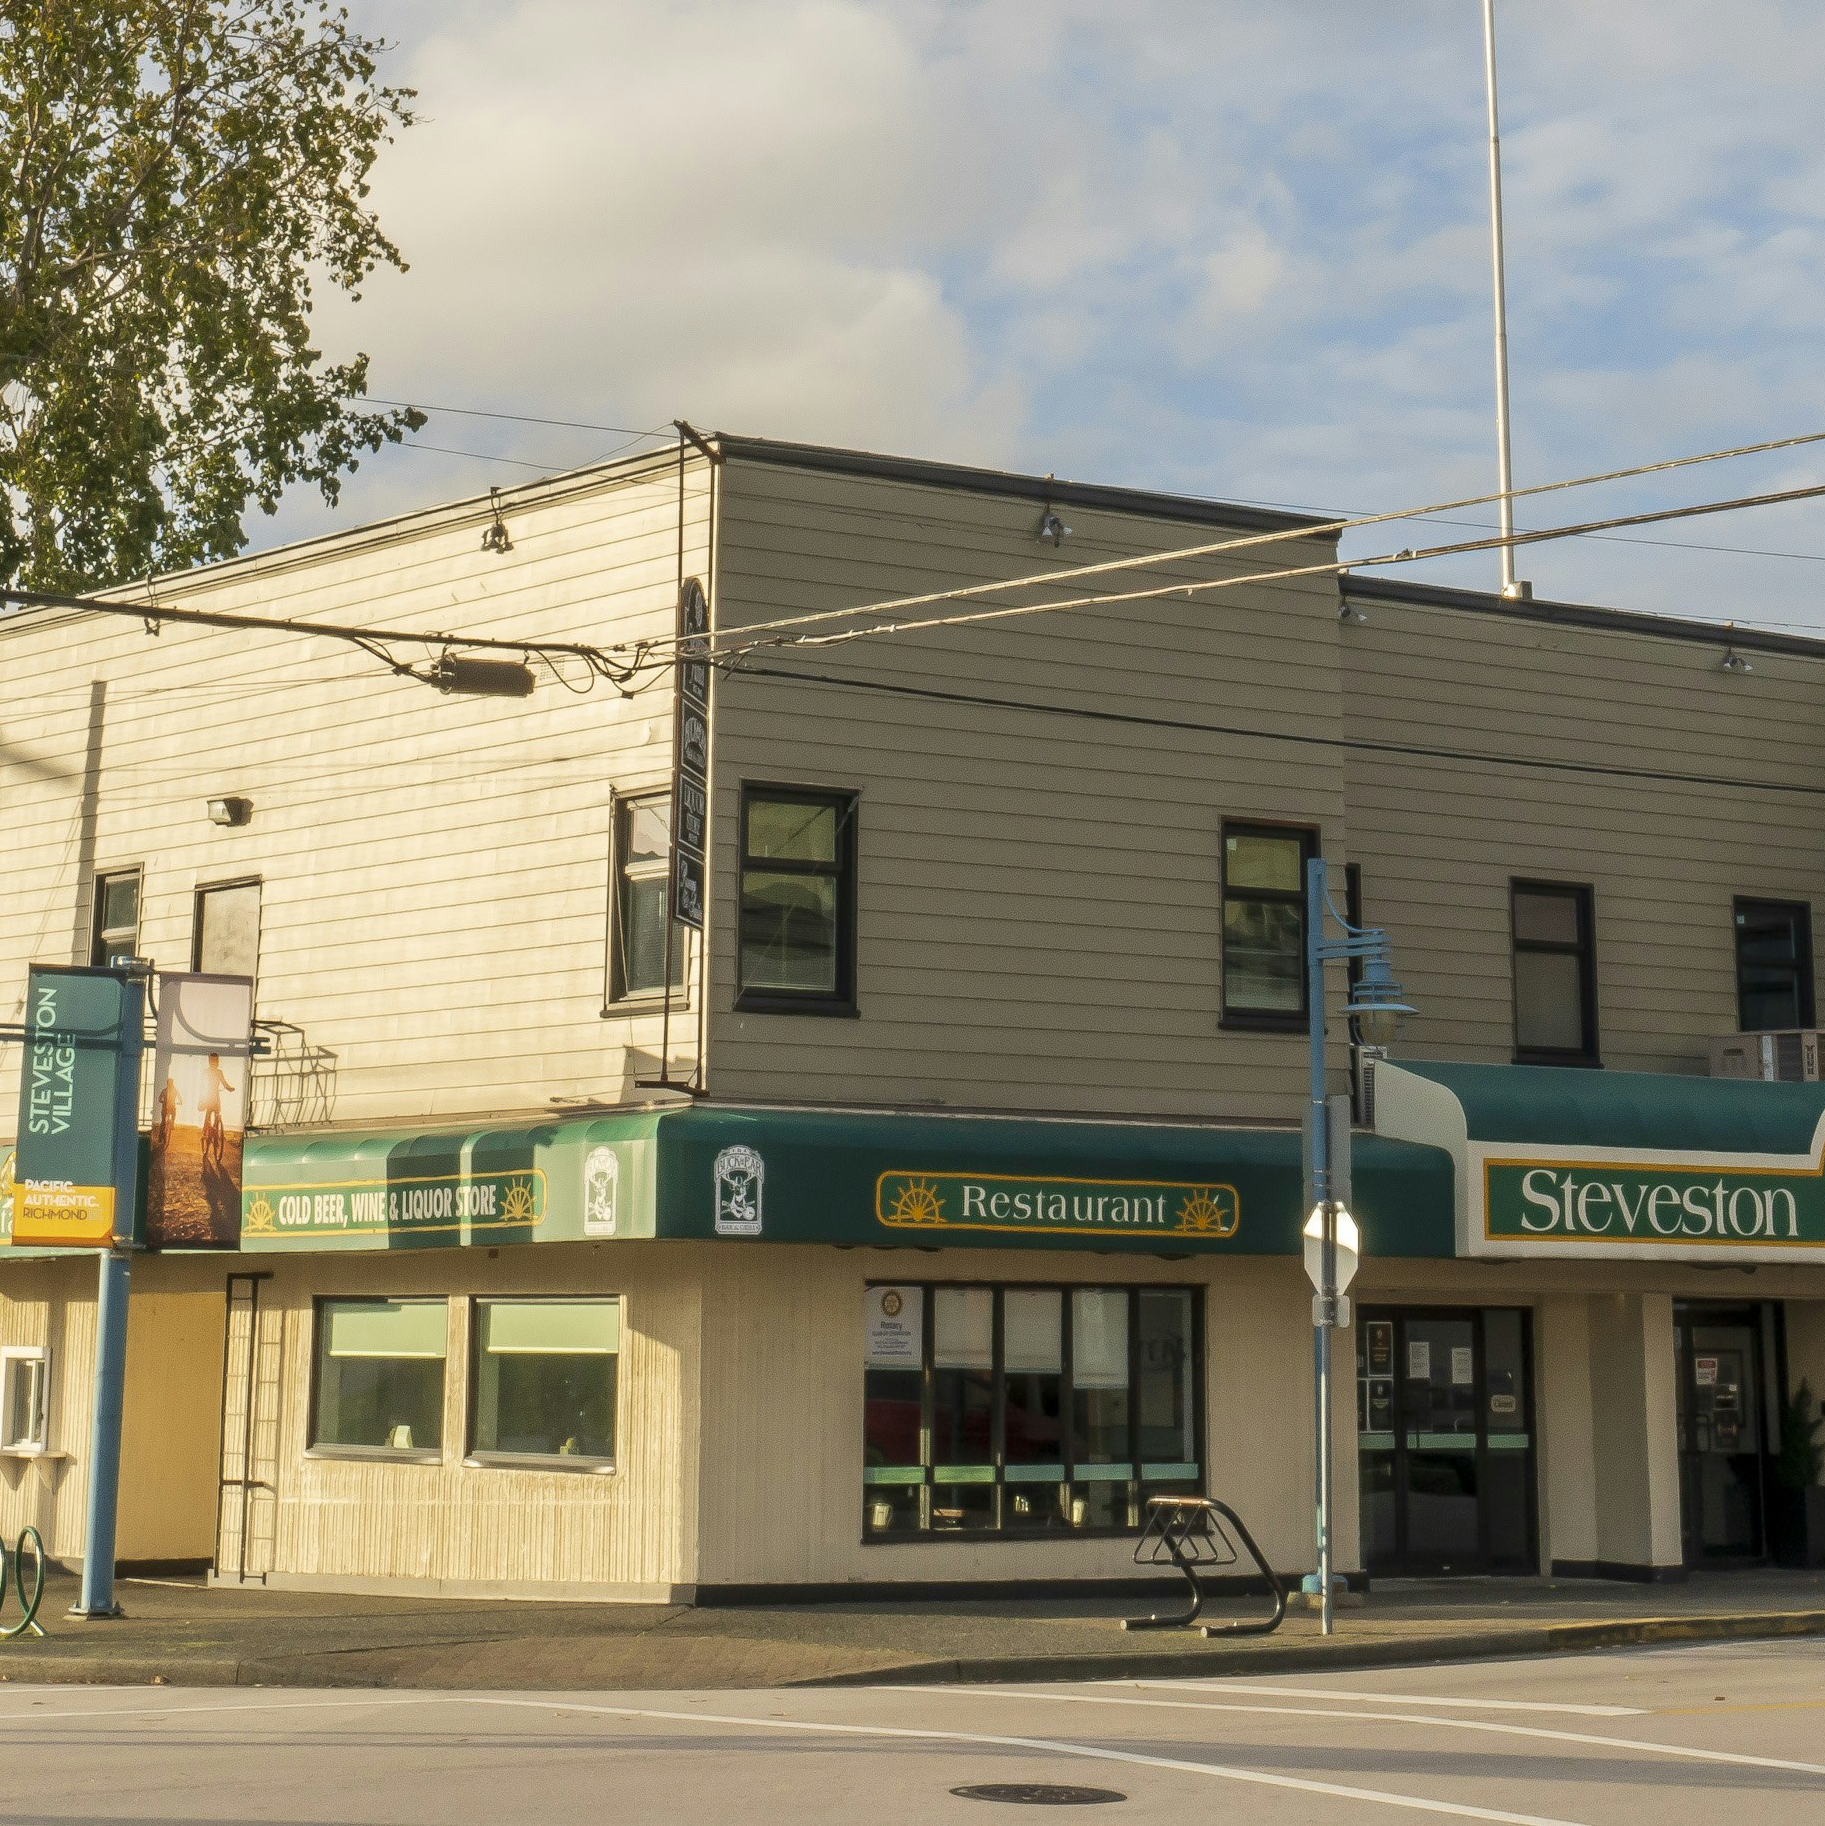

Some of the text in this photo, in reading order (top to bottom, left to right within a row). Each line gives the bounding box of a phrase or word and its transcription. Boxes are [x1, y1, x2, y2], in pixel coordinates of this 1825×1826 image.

[29, 988, 57, 1134] STEVESTON
[51, 1033, 75, 1135] VILLAGE
[23, 1194, 99, 1207] AUTHENTIC.
[24, 1178, 75, 1192] PACIFIC.
[962, 1185, 1166, 1224] Restaurant
[1521, 1169, 1799, 1236] Steveston
[23, 1207, 88, 1220] RICHMOND
[278, 1184, 497, 1228] COLD BEER, WINE & LIQUOR STORE
